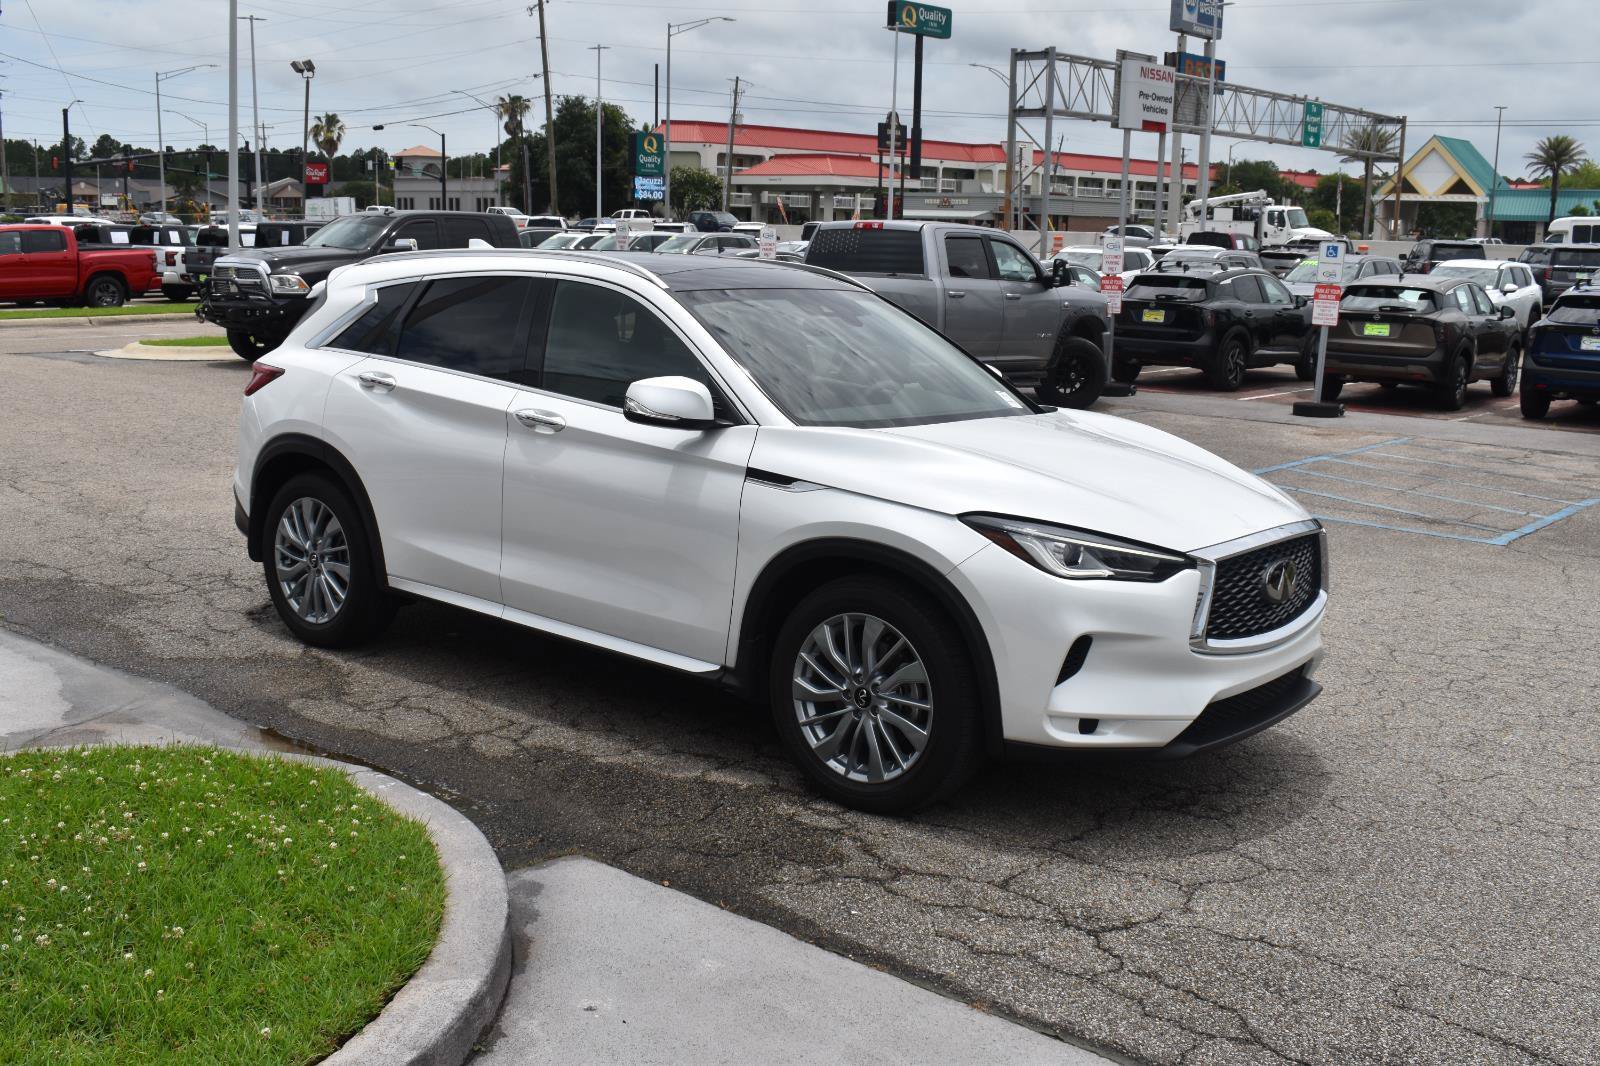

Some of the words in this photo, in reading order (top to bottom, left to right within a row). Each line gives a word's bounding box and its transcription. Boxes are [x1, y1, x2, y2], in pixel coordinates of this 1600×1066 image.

[902, 5, 917, 28] Q
[919, 8, 947, 25] Quality
[1140, 66, 1174, 83] NISSAN
[1138, 90, 1173, 104] Pre-Owned
[1142, 103, 1168, 115] Vehicles
[643, 136, 658, 154] Q
[638, 154, 661, 165] Quality
[639, 176, 663, 185] Jacuzzi
